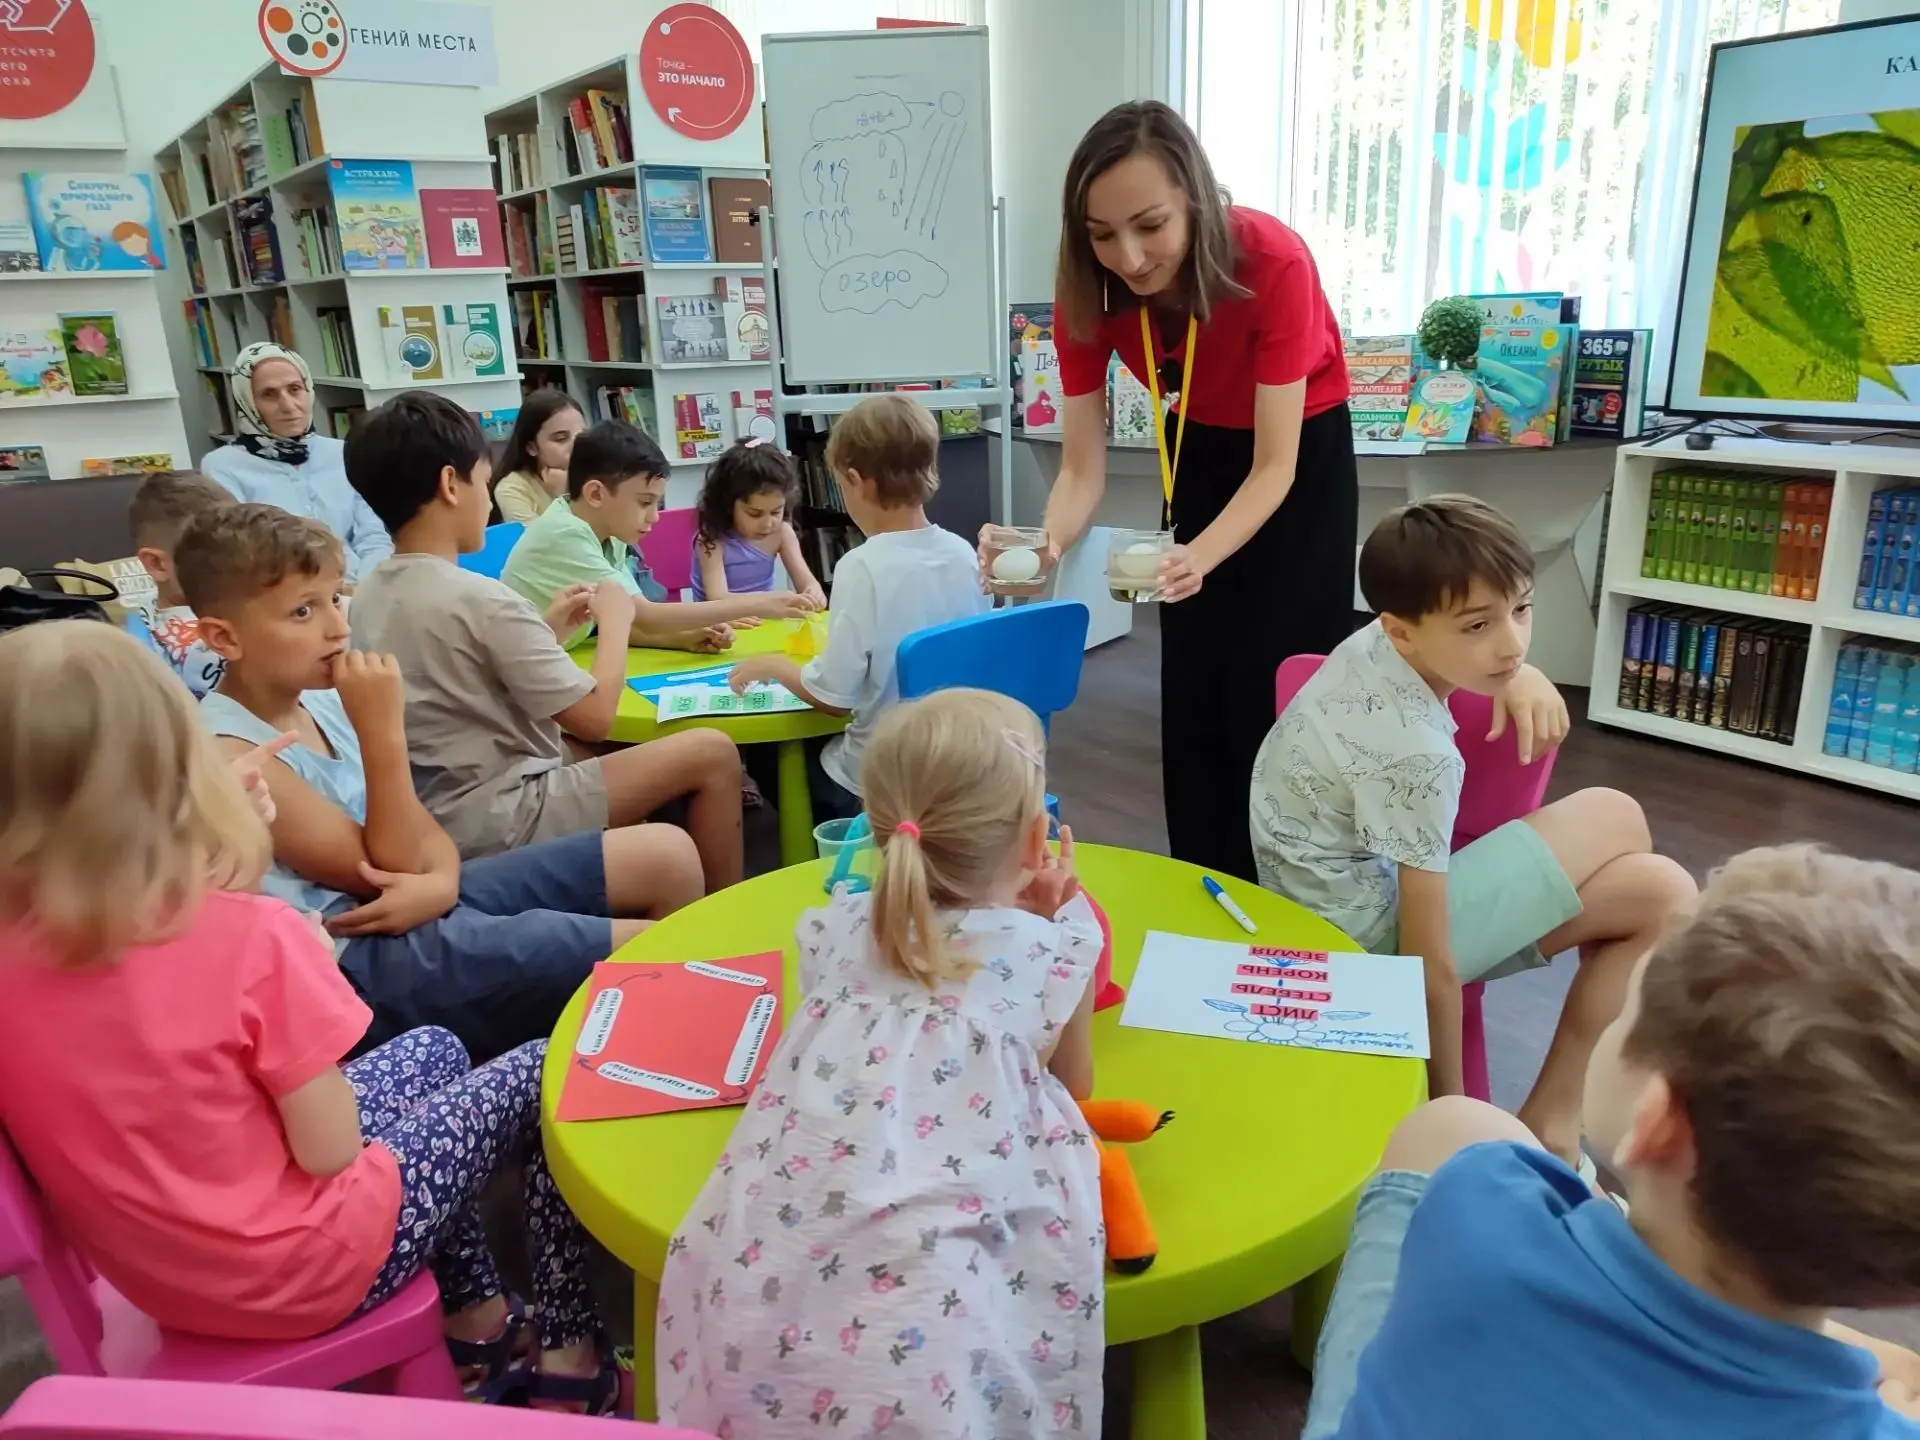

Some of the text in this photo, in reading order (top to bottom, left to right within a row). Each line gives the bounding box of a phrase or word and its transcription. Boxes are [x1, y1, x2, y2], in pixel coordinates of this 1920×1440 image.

[350, 28, 477, 52] ГЕНИЙ МЕСТА
[656, 57, 685, 71] Точка
[0, 76, 32, 86] еха
[658, 72, 726, 88] ЭТО НАЧАЛО
[839, 269, 911, 293] озеро
[1582, 338, 1613, 355] 365
[1252, 947, 1326, 961] ЗЕМЛЯ
[1242, 965, 1329, 981] КОРЕНЬ
[1236, 984, 1332, 1001] СТЕБЕЛЬ
[1256, 1004, 1318, 1020] ЛИСТ
